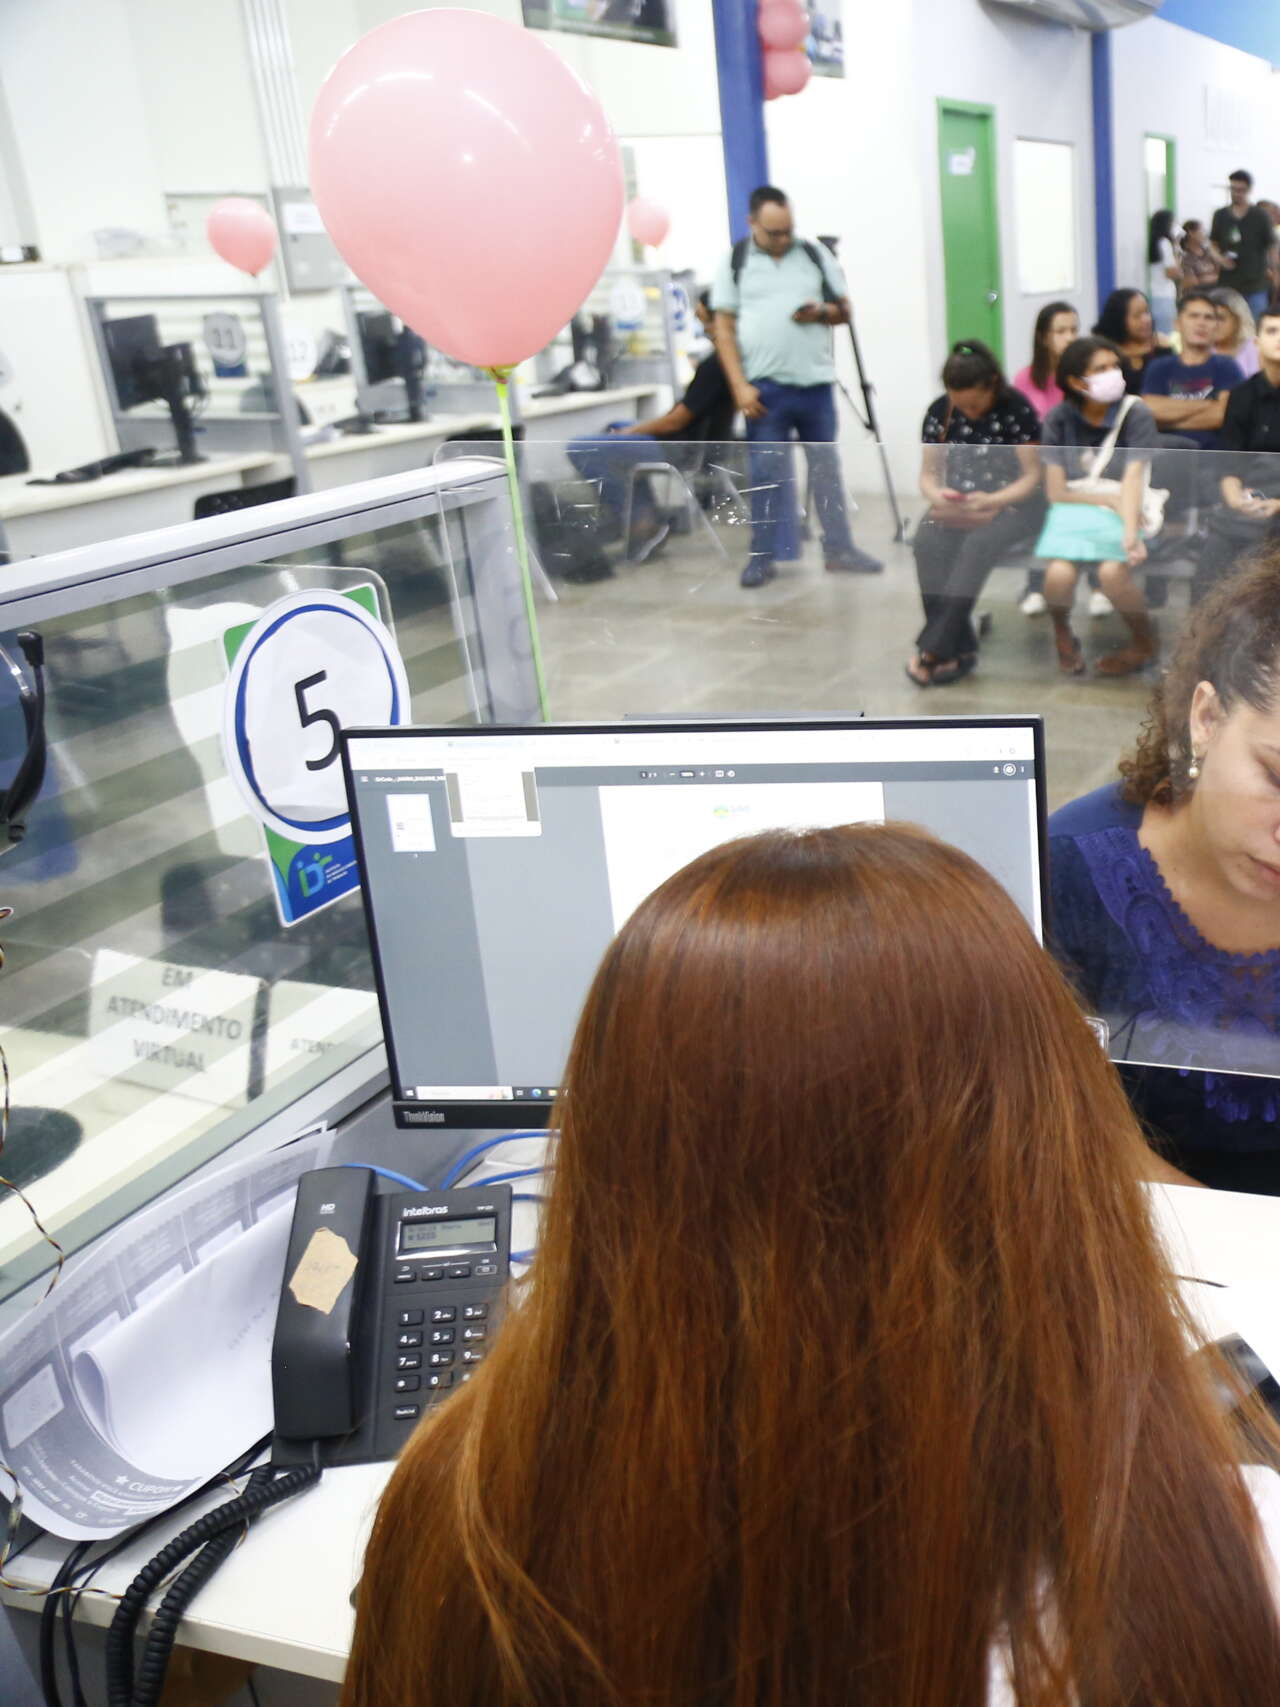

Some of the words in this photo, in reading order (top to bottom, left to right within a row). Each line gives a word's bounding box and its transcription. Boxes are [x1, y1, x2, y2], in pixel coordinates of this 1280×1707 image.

[294, 669, 341, 771] 5
[162, 968, 193, 989] EM
[106, 995, 243, 1041] ATENDIMENTO
[134, 1038, 205, 1073] VIRTUAL
[403, 1111, 445, 1123] ThinkVision
[403, 1206, 448, 1217] intelbras
